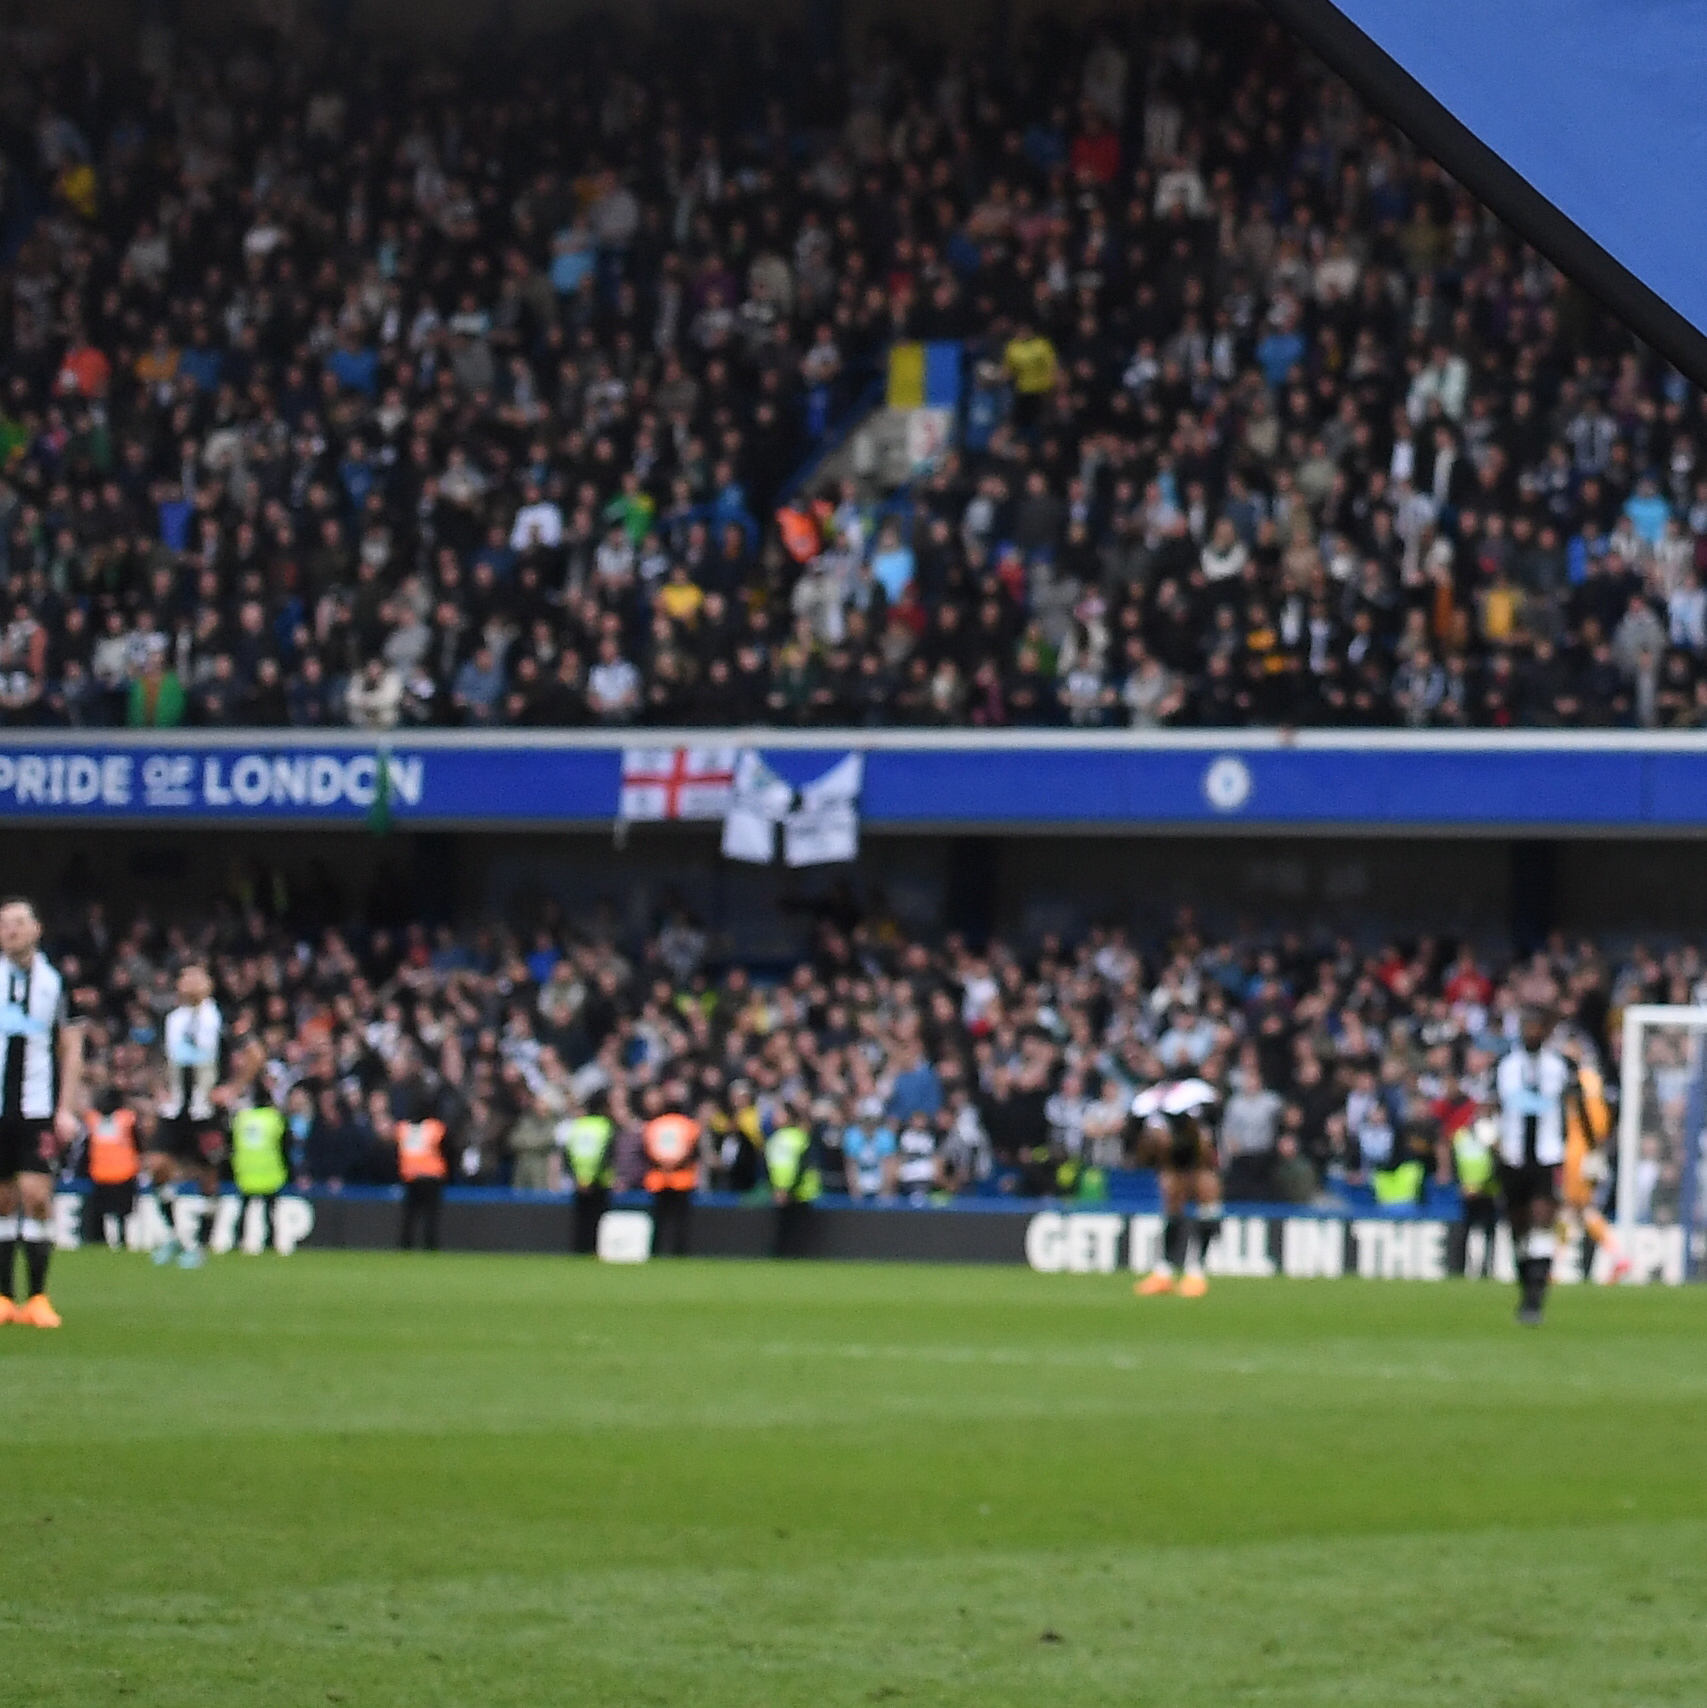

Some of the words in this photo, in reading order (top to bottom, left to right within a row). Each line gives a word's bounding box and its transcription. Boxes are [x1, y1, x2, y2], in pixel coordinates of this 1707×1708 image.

[142, 755, 194, 792] OF
[1024, 1211, 1126, 1274] GET
[1281, 1217, 1347, 1279] IN
[1351, 1220, 1445, 1281] THE
